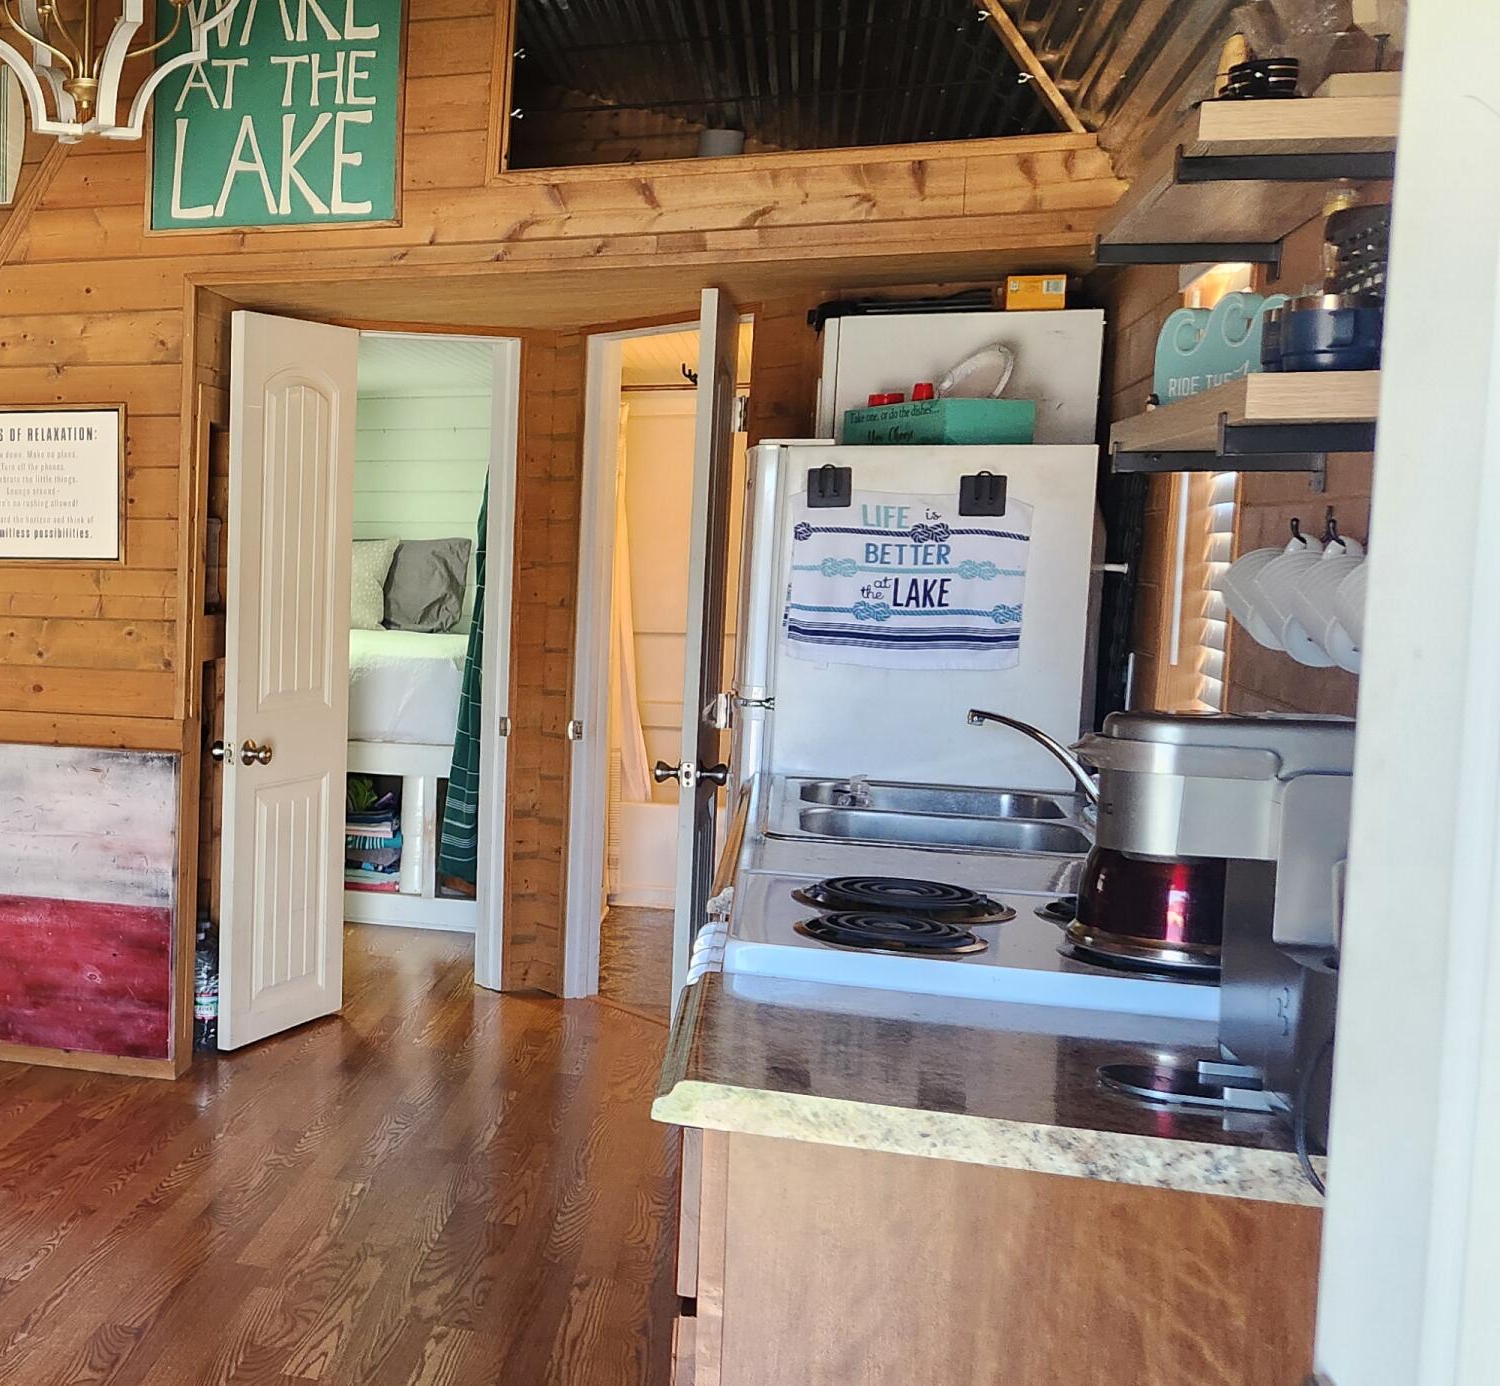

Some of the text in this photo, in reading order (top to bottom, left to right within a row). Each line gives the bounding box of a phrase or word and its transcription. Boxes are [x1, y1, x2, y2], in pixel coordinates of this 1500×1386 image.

[174, 50, 377, 112] AT THE
[171, 109, 373, 219] LAKE
[1168, 376, 1200, 397] RIDE
[899, 406, 910, 418] the
[9, 427, 22, 442] OF
[27, 426, 98, 442] RELAXATION:
[27, 450, 45, 459] Make
[1, 463, 15, 471] Turn
[17, 462, 27, 471] off
[28, 462, 38, 471] the
[22, 475, 33, 483] the
[35, 475, 52, 483] little
[22, 499, 49, 509] rushing
[13, 515, 24, 524] the
[26, 515, 51, 524] horizon
[53, 515, 65, 524] and
[67, 515, 85, 524] think
[87, 515, 94, 524] of
[861, 504, 942, 529] LIFE is
[34, 528, 93, 540] possibilities.
[864, 542, 951, 566] BETTER
[874, 576, 894, 589] at
[860, 577, 952, 609] the LAKE
